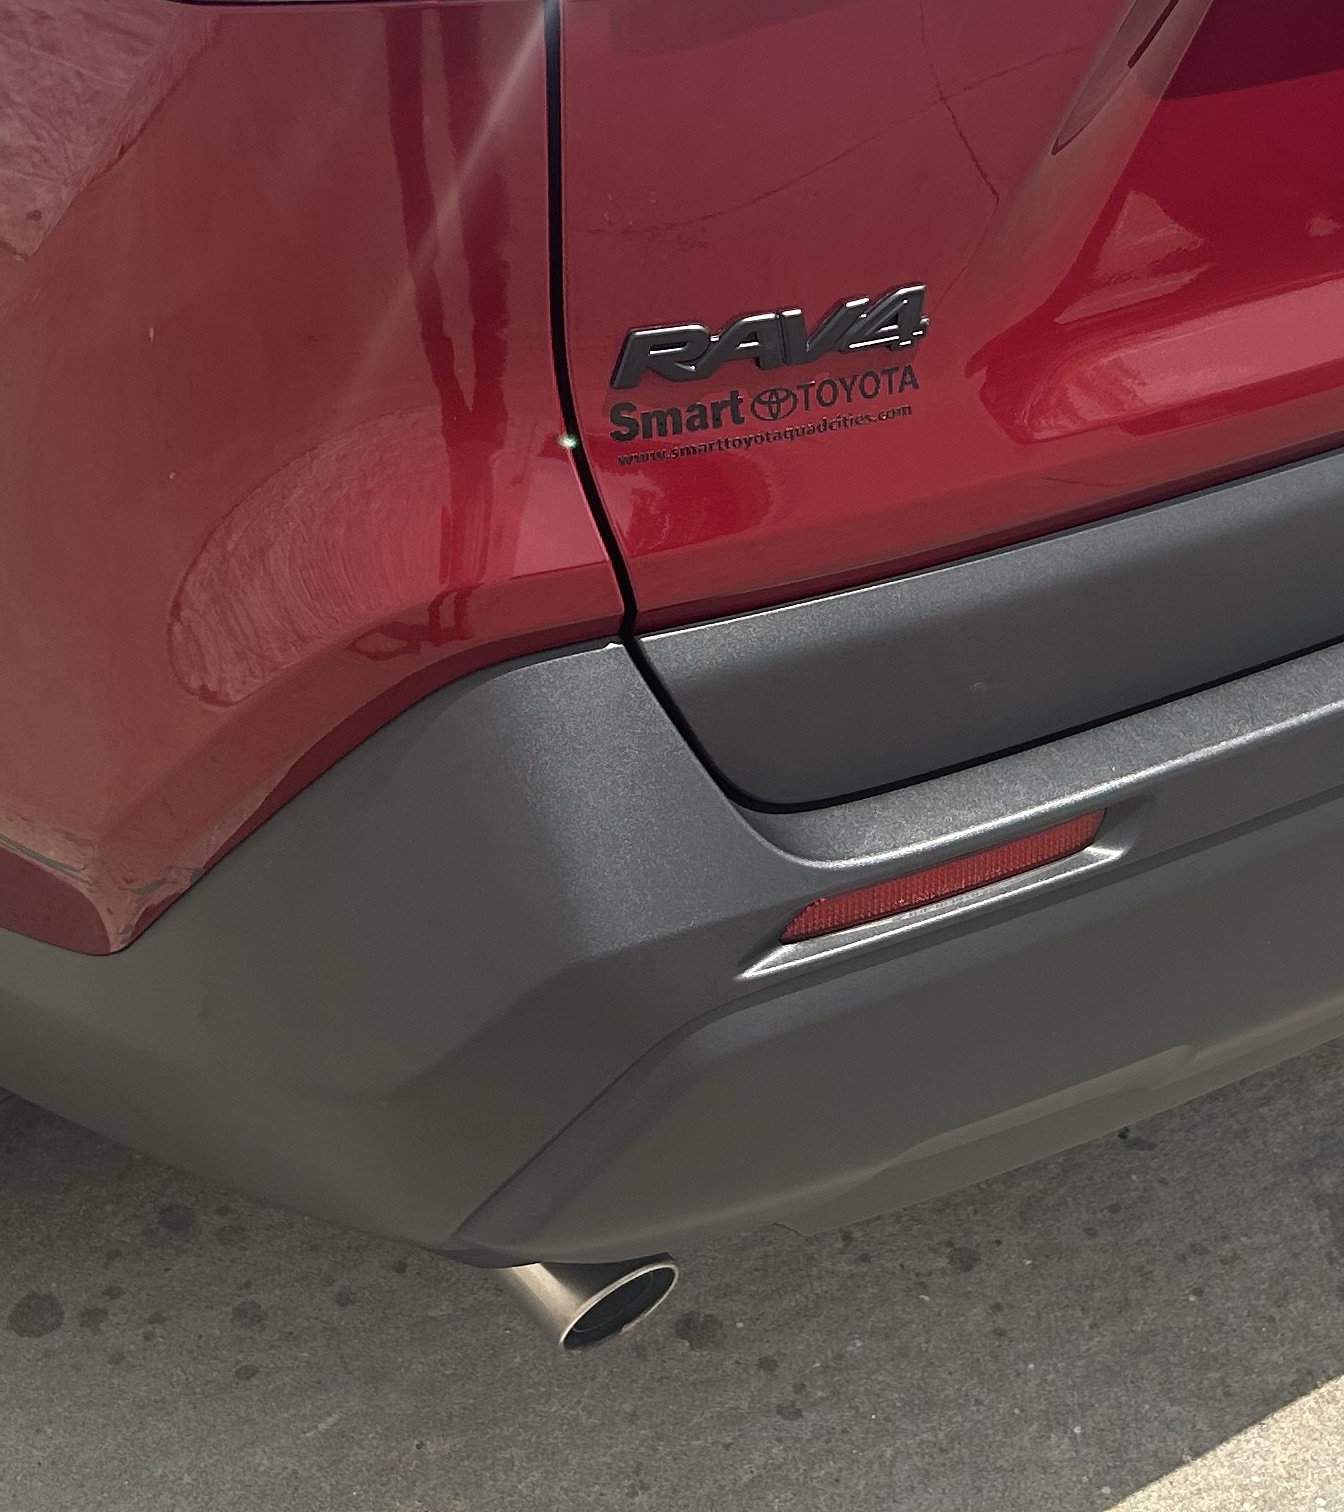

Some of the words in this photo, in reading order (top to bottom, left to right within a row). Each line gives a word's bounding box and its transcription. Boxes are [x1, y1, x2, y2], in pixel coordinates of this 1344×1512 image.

[609, 282, 930, 389] RAV4
[609, 390, 746, 442] Smart
[796, 364, 920, 411] TOYOTA
[616, 403, 913, 466] www.smarttoyotaquadcities.com
